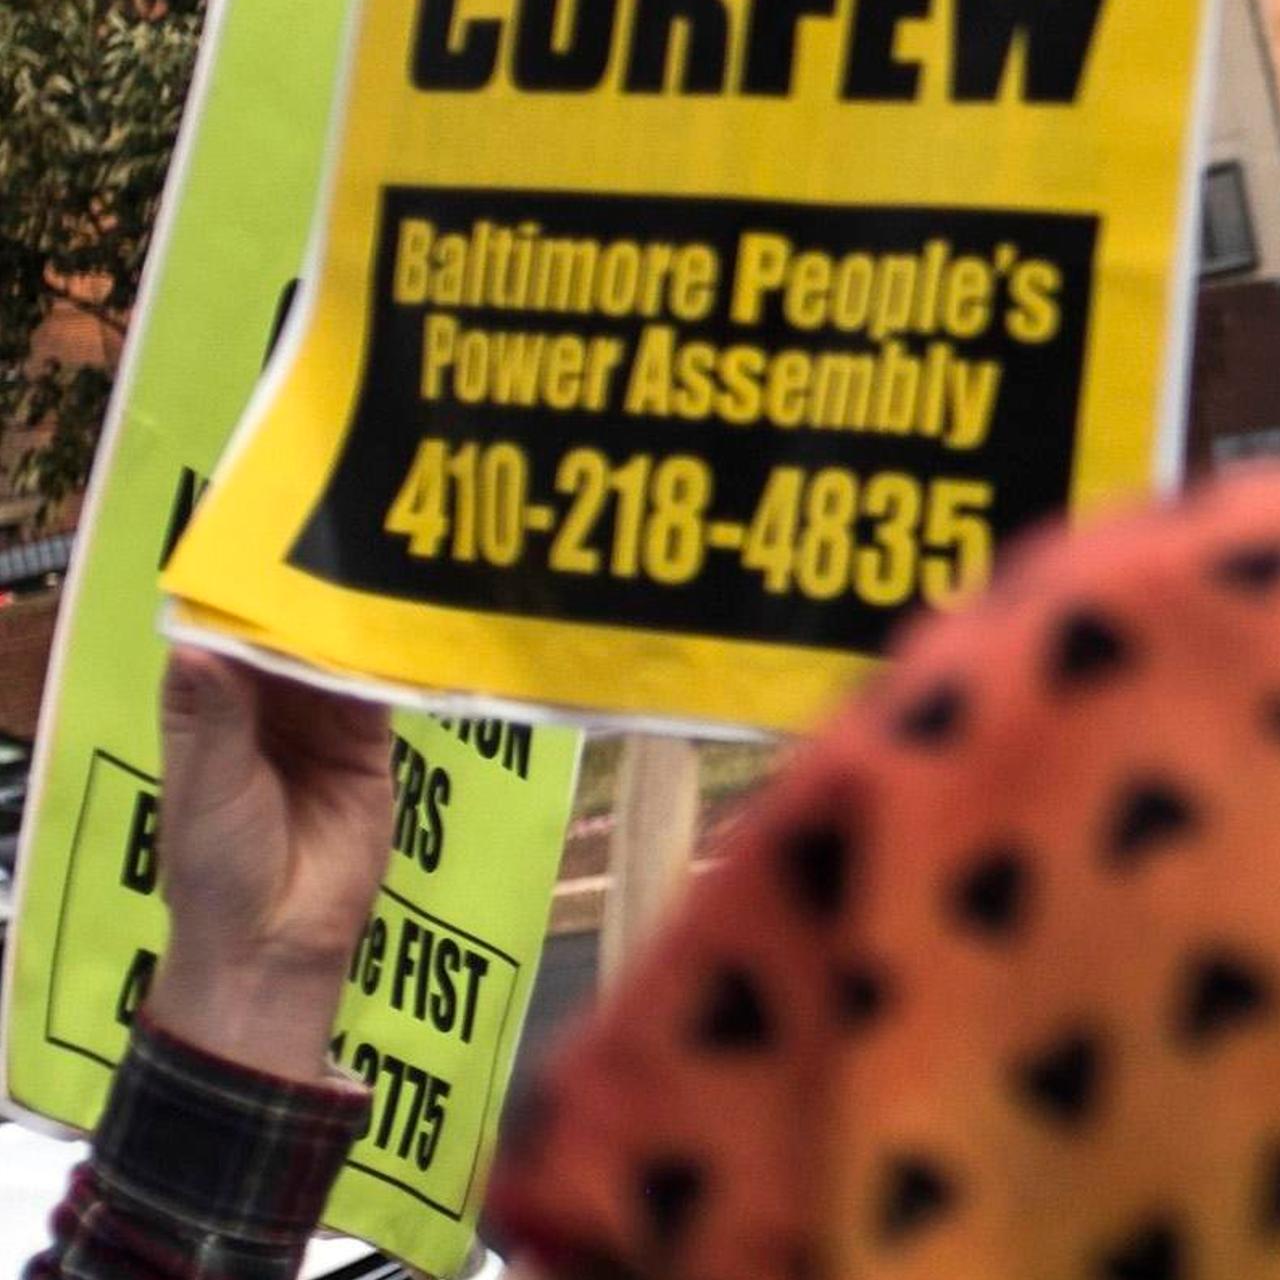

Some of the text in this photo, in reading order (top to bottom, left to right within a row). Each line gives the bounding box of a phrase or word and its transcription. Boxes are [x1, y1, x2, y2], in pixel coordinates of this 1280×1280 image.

[393, 217, 1063, 344] Baltimore People's
[420, 316, 626, 411] Power
[625, 326, 1003, 450] Assembly
[385, 437, 995, 612] 410-218-4835
[390, 918, 490, 1044] FIST
